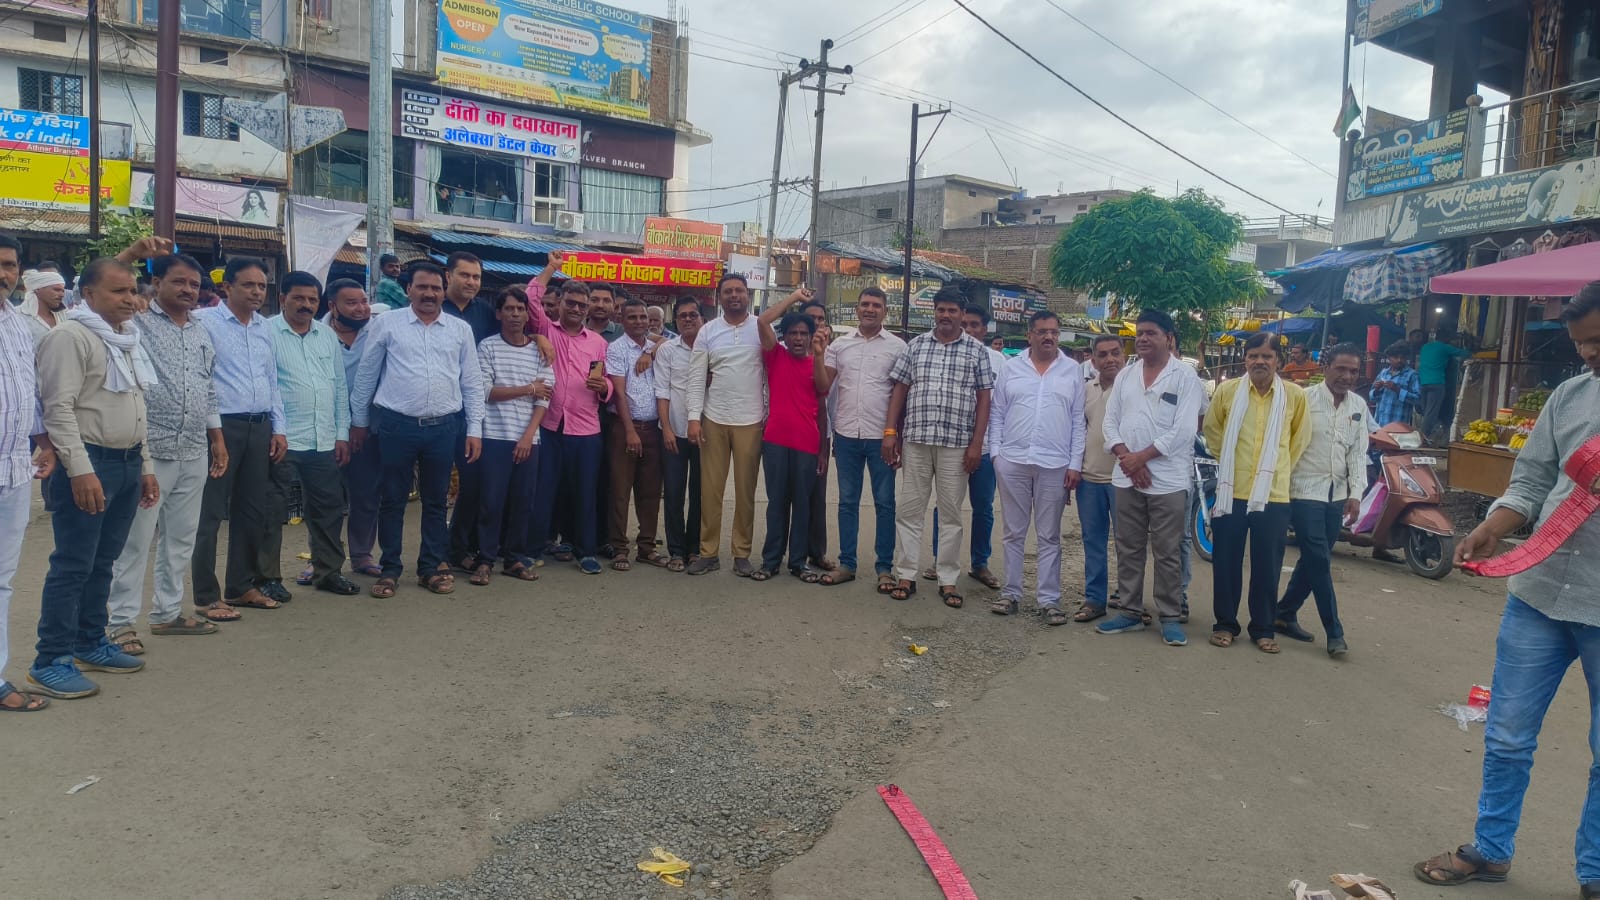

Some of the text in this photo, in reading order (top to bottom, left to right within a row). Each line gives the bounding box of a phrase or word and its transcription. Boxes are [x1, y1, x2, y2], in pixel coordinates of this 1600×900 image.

[445, 0, 498, 19] ADMISSION
[558, 0, 593, 13] PUBLIC
[595, 5, 635, 23] SCHOOL
[456, 19, 485, 32] OPEN
[451, 42, 486, 55] NURSERY
[32, 114, 81, 129] इंडिया
[486, 109, 507, 127] का
[512, 114, 579, 139] दवाखाना
[14, 129, 34, 140] of
[37, 131, 81, 146] India
[445, 126, 494, 147] अलेक्सा
[497, 132, 526, 152] डेंटल
[530, 138, 558, 157] केयर
[53, 144, 80, 155] Branch
[612, 159, 645, 169] BRANCH
[647, 222, 675, 246] बीकानेर
[675, 225, 699, 249] मिष्ठान
[562, 256, 618, 280] बीकानेर
[621, 258, 665, 283] मिष्ठान
[669, 268, 712, 286] भण्डार
[880, 275, 917, 294] Sanjy
[991, 294, 1026, 311] संजय
